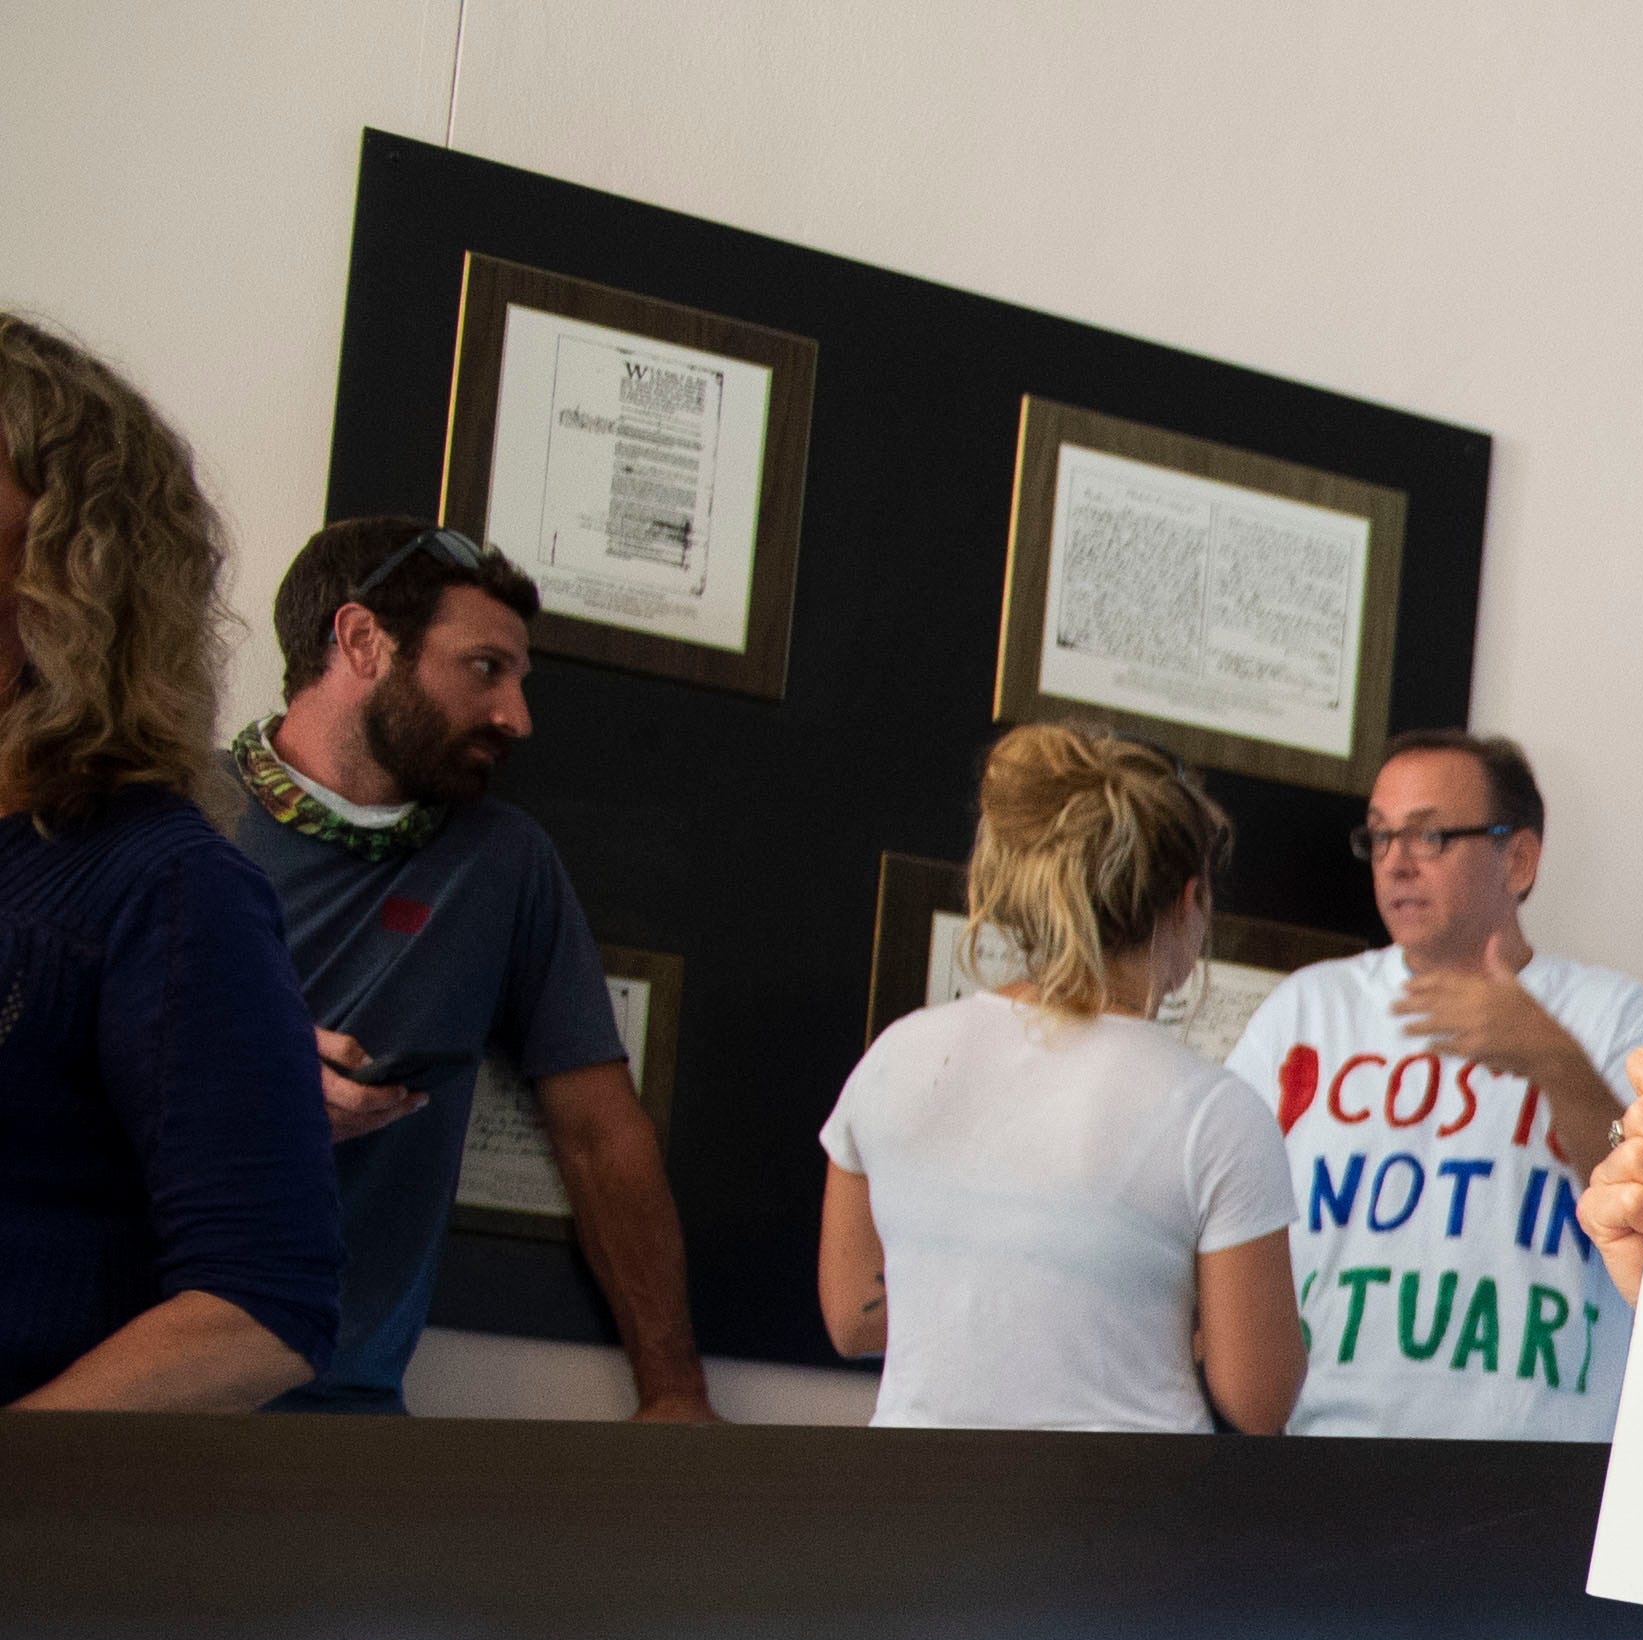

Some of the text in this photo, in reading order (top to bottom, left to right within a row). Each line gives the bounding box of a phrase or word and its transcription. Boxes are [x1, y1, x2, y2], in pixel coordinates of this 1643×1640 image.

[1327, 1053, 1572, 1164] COST
[1308, 1152, 1595, 1266] NOT IN
